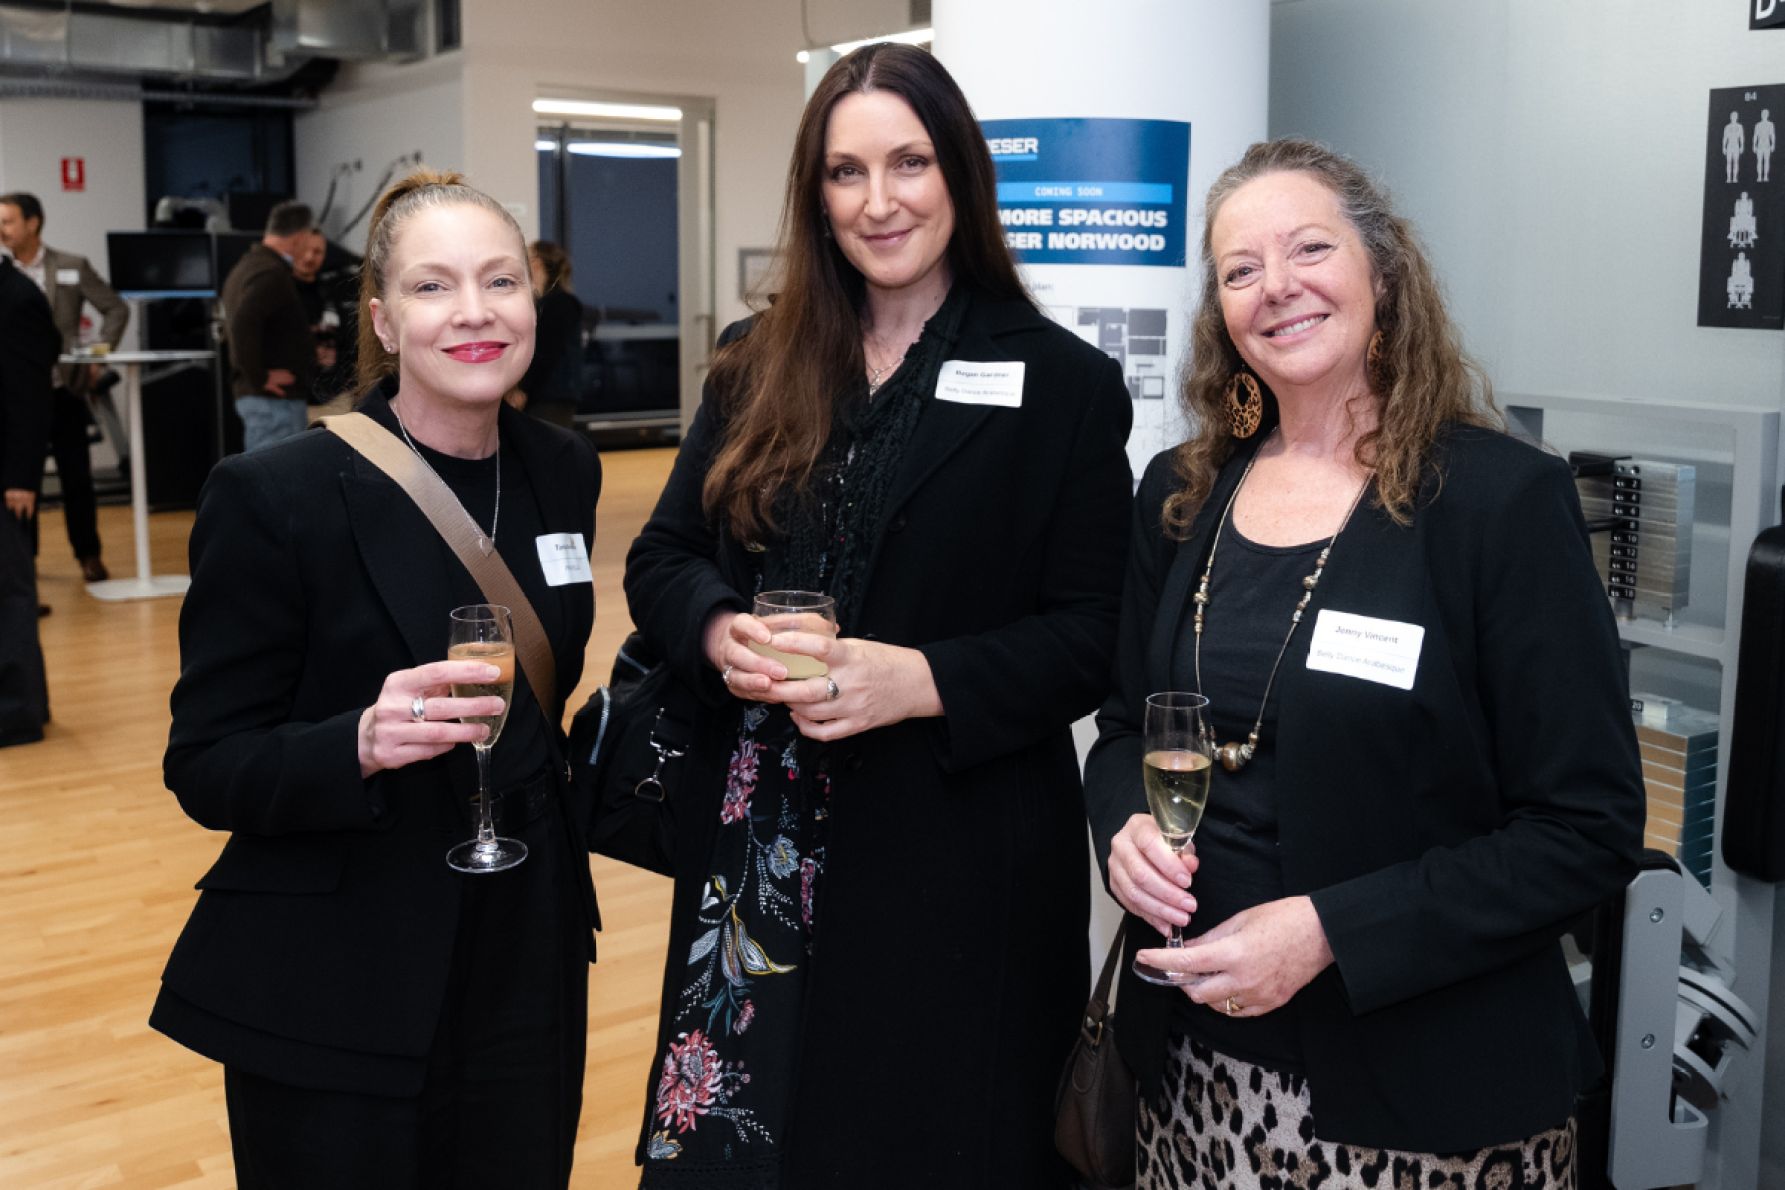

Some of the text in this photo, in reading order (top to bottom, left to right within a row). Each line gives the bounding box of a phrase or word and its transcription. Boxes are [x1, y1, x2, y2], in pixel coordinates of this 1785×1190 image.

[986, 137, 1039, 154] ESER
[1034, 186, 1104, 197] COMING SOON
[998, 208, 1168, 227] MORE SPACIOUS
[1048, 232, 1166, 251] NORWOOD
[1335, 625, 1399, 644] Jenny Vincent
